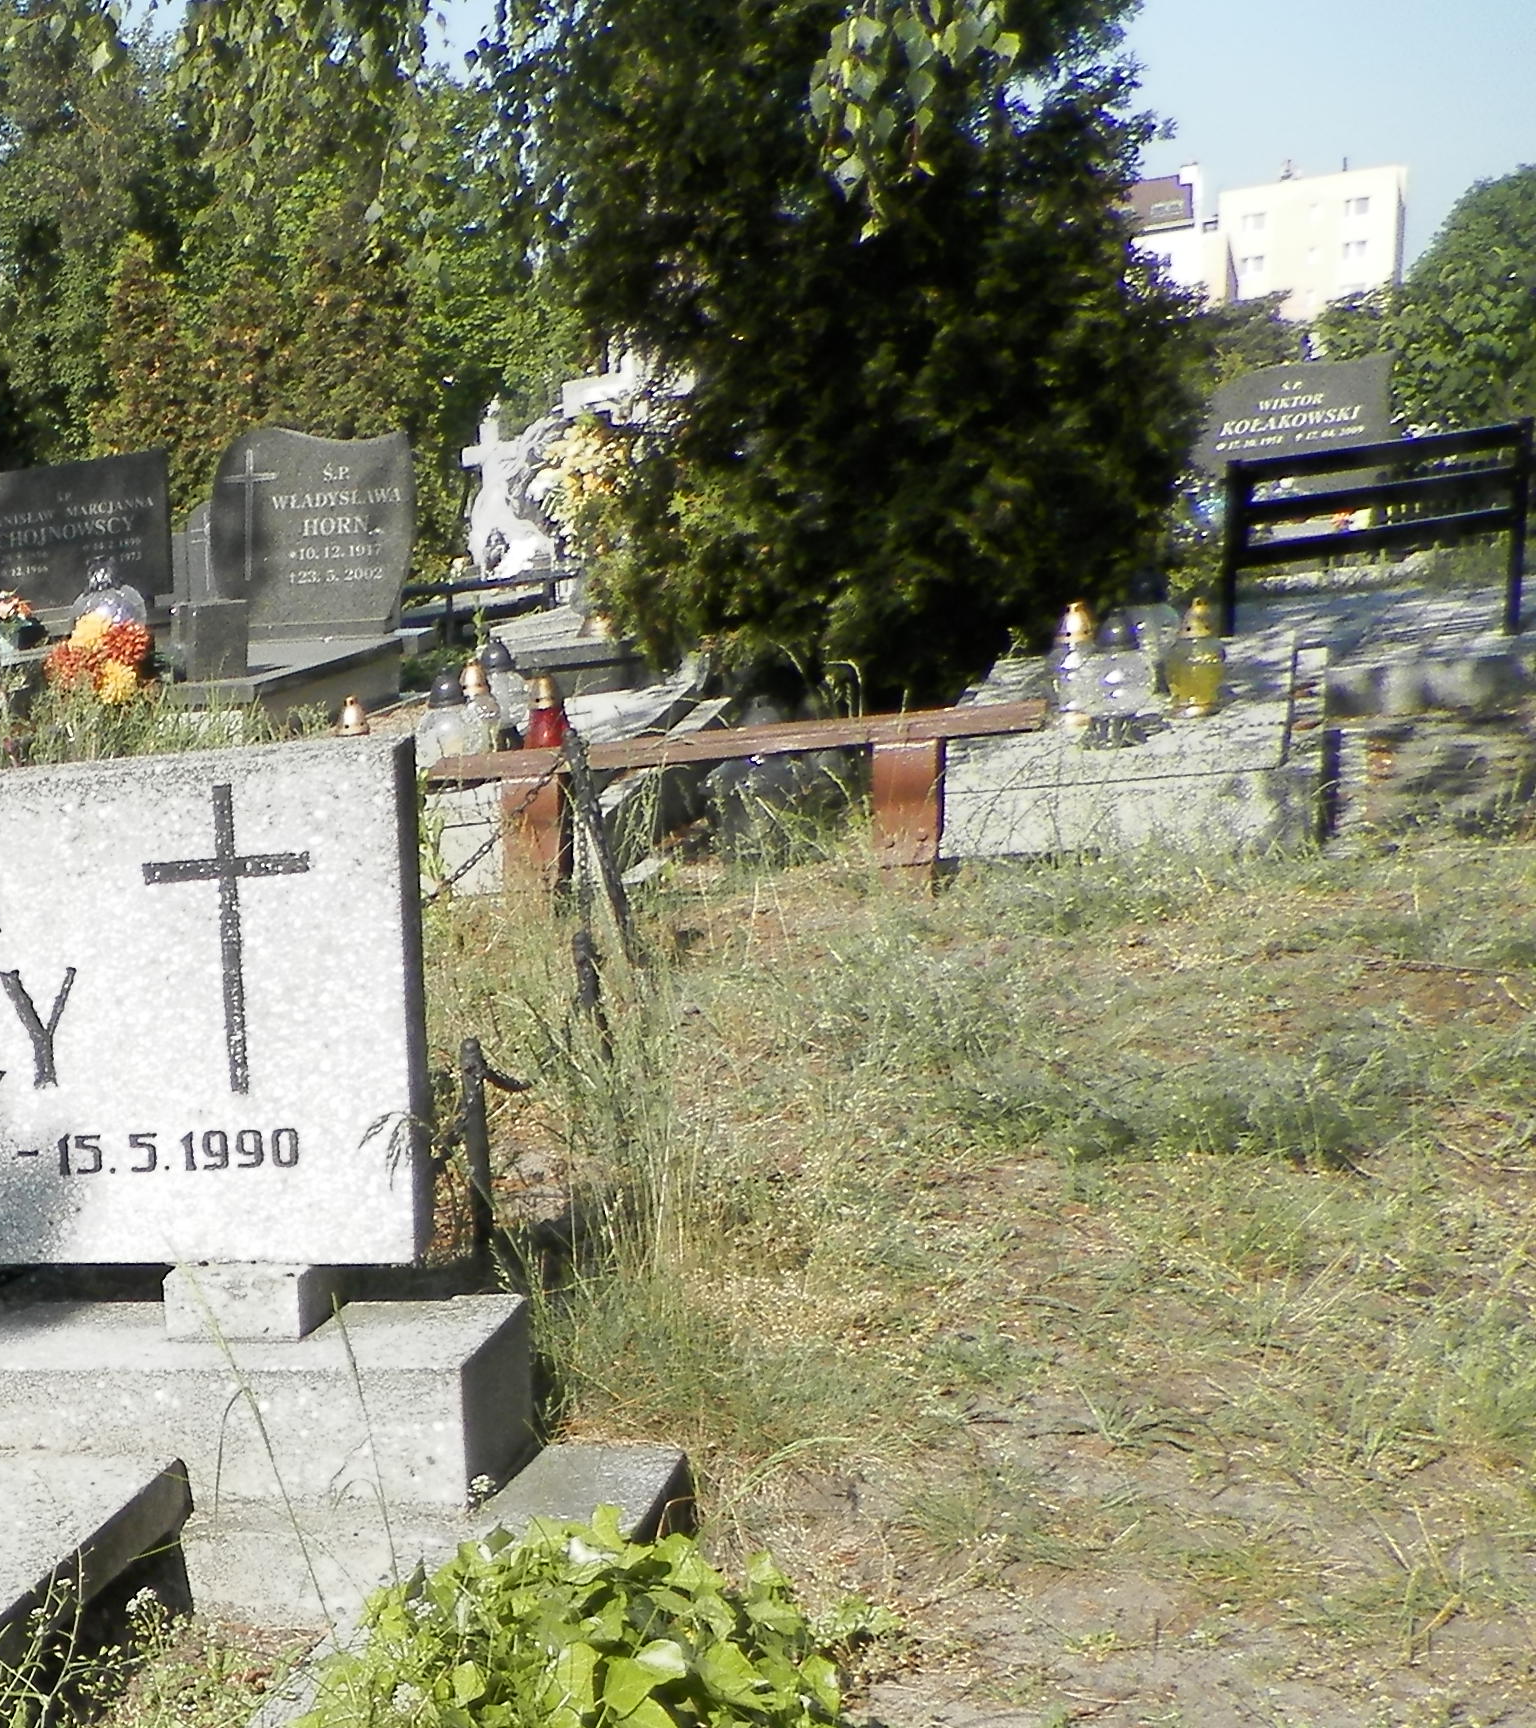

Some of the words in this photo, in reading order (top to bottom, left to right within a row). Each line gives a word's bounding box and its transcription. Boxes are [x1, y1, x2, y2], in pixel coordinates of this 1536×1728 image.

[1258, 393, 1324, 411] WIKTOR
[1219, 405, 1362, 437] KOŁAKOWSKI
[302, 515, 369, 537] HORN
